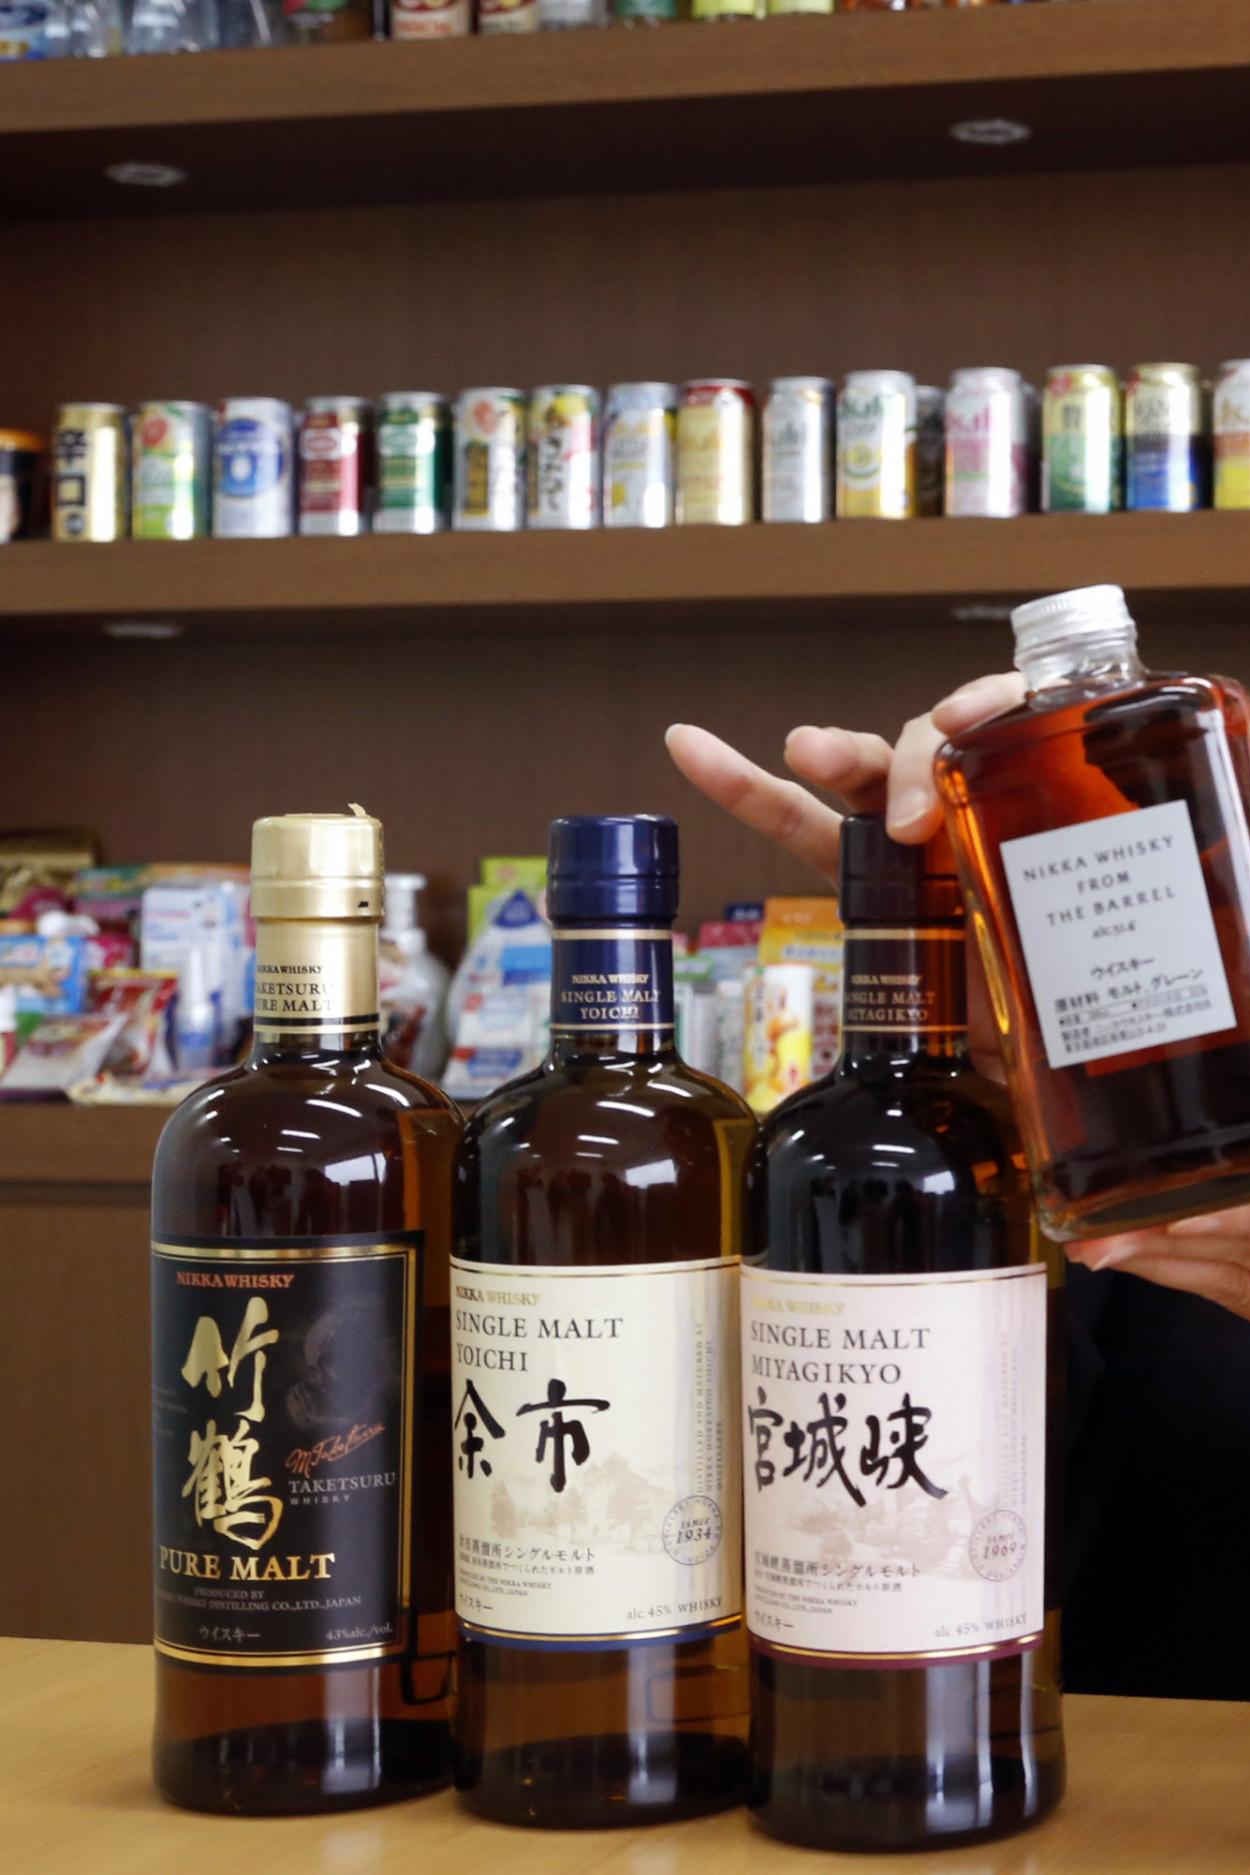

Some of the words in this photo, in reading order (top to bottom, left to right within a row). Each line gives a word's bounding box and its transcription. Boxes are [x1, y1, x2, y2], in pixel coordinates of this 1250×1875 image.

[1023, 857, 1088, 883] NIKKA
[1093, 834, 1175, 865] WHISKY
[1076, 871, 1131, 894] FROM
[1046, 904, 1085, 926] THE
[1093, 885, 1176, 916] BARREL
[1090, 957, 1155, 981] ウイスキー
[282, 1000, 331, 1012] MALT
[560, 991, 616, 1004] SINGLE
[621, 990, 661, 1003] MALT
[891, 992, 936, 1004] MALT
[580, 1007, 640, 1019] YOICHI
[176, 1272, 223, 1287] NIKKA
[224, 1274, 295, 1288] WHISKY
[486, 1290, 541, 1306] WHISKY
[456, 1310, 527, 1338] SINGLE
[537, 1318, 623, 1339] MALT
[750, 1320, 831, 1349] SINGLE
[843, 1328, 930, 1349] MALT
[456, 1342, 528, 1371] YOICHI
[751, 1354, 901, 1384] MIYAGIKYO
[181, 1296, 284, 1550] 竹鶴
[454, 1378, 611, 1493] 余市
[288, 1472, 396, 1494] TAKETSURU
[290, 1494, 350, 1505] WHISKY
[677, 1527, 711, 1544] 1934
[159, 1546, 221, 1578] PURE
[230, 1552, 335, 1580] MALT
[199, 1626, 260, 1642] ウイスキー
